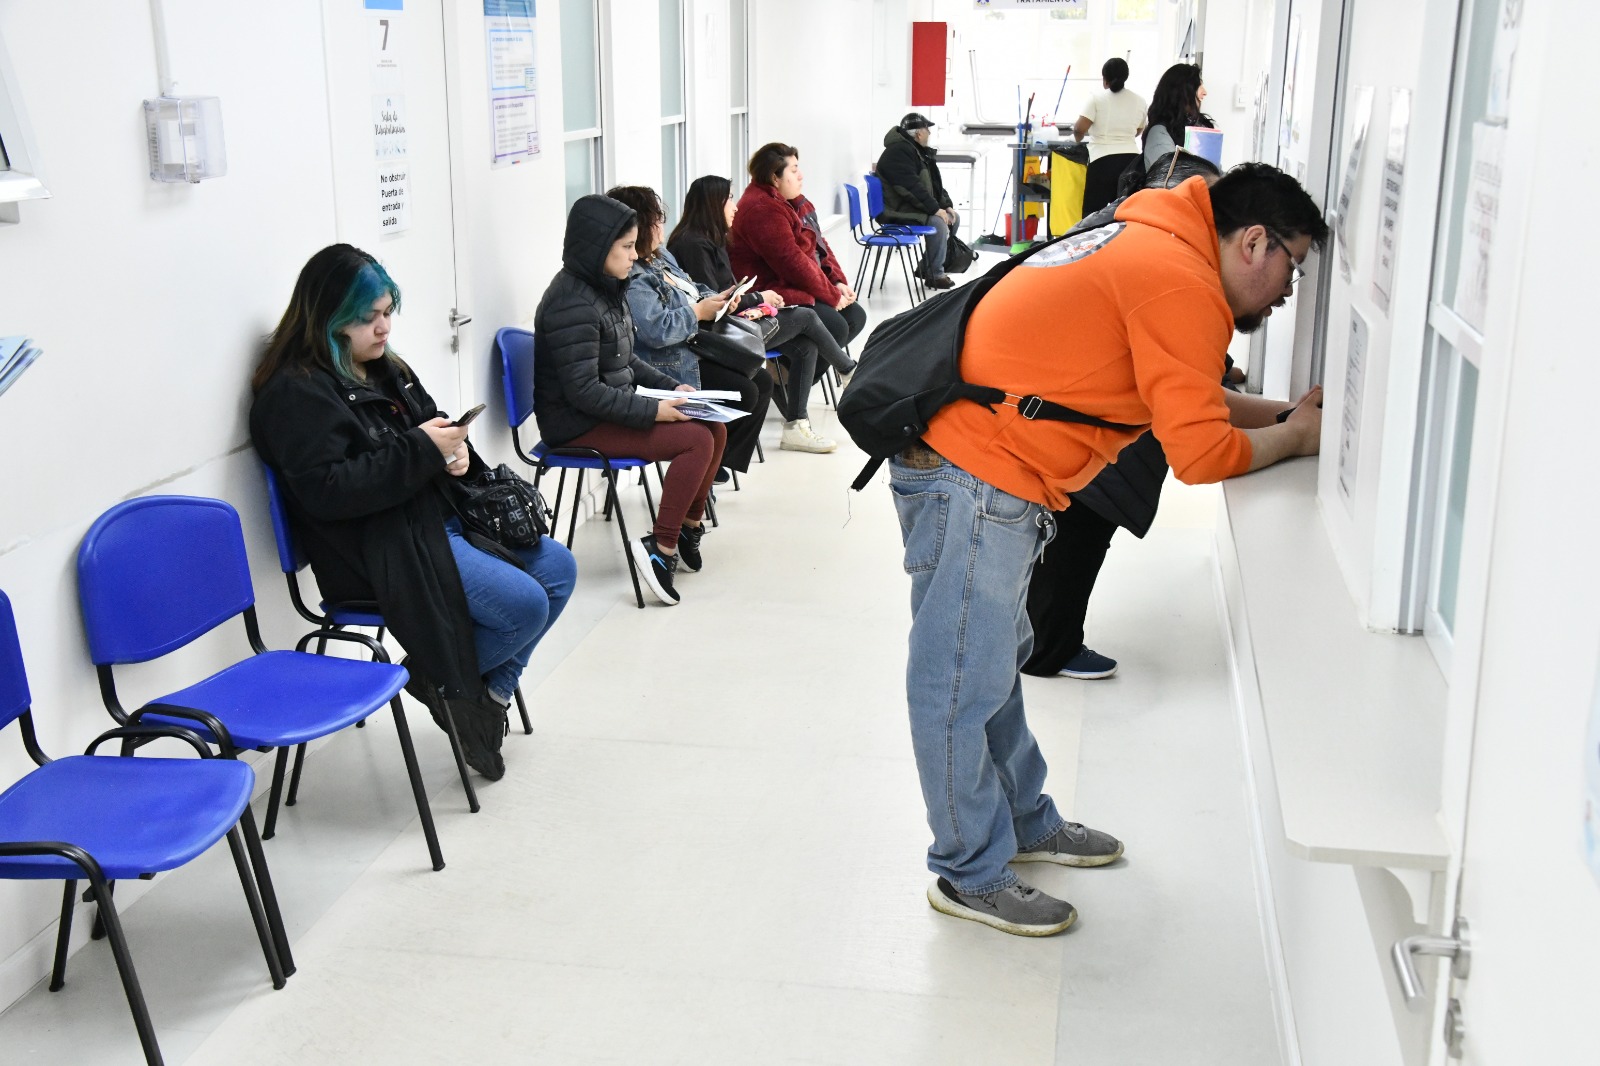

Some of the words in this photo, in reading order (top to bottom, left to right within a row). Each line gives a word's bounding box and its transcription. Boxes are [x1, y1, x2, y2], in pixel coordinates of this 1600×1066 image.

[379, 19, 389, 51] 7
[380, 174, 388, 183] No
[381, 189, 398, 198] Puerta
[398, 187, 404, 196] de
[382, 201, 401, 211] entrada
[383, 216, 397, 226] salida
[508, 509, 524, 523] BE
